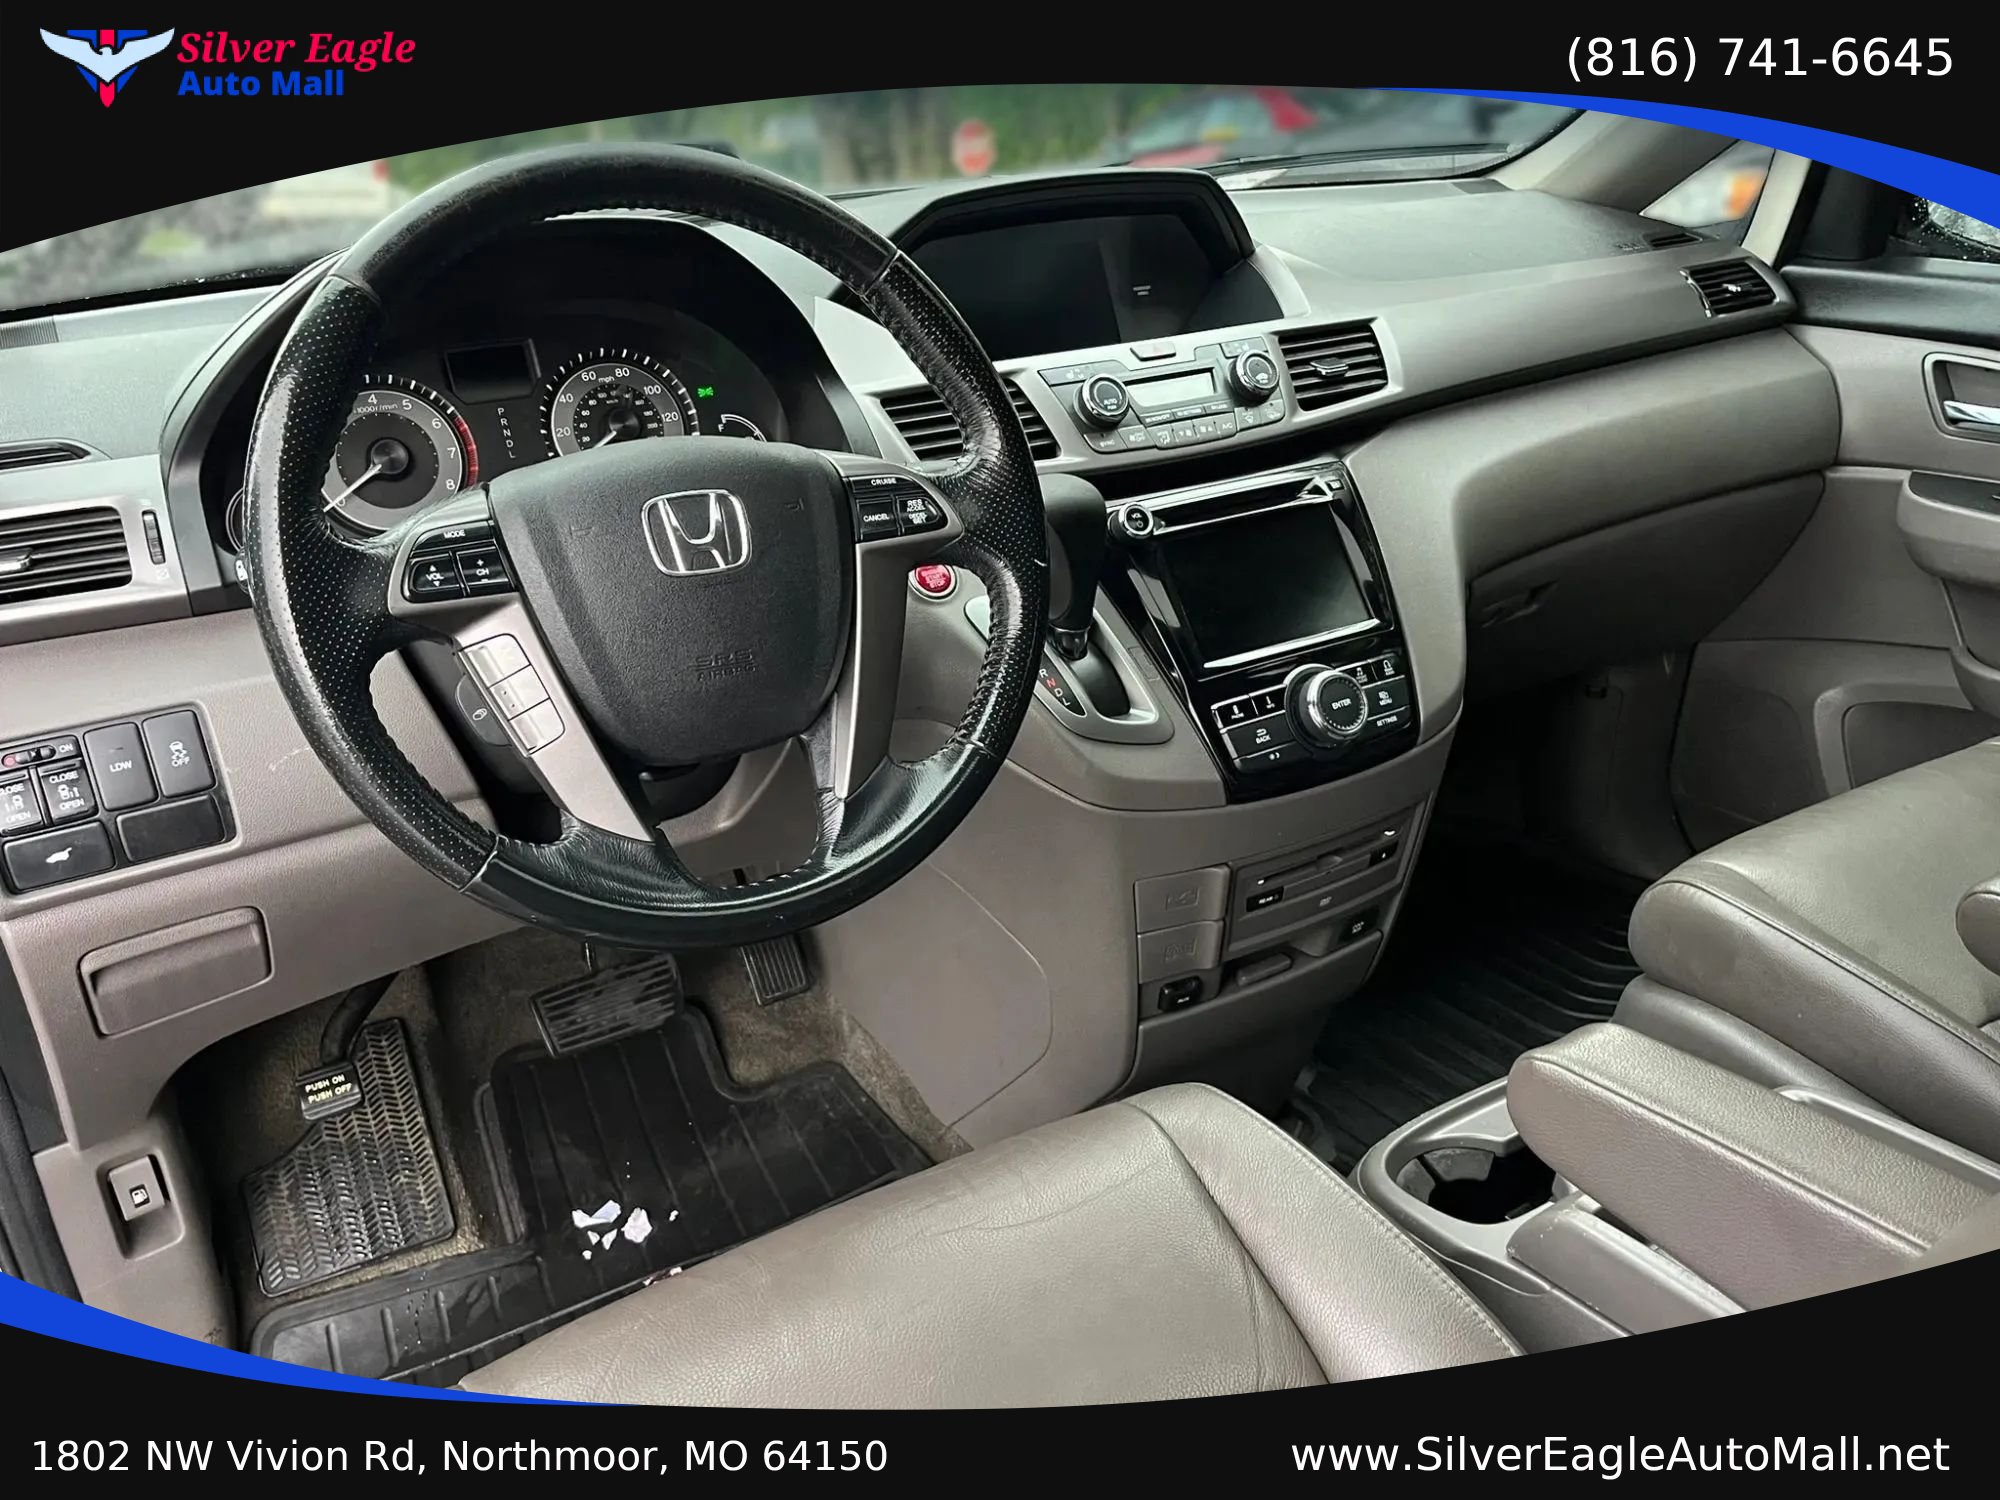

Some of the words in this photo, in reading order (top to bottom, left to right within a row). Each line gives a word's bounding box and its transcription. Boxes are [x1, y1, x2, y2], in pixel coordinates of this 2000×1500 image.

[581, 371, 597, 381] 60
[614, 367, 630, 378] 80
[598, 375, 615, 383] mph
[643, 384, 662, 396] 100
[367, 393, 378, 404] 4
[402, 398, 413, 410] 5
[559, 393, 574, 403] 40
[661, 410, 679, 423] 120
[431, 417, 443, 430] 6
[717, 423, 725, 433] F
[555, 426, 571, 438] 20
[447, 446, 457, 460] 7
[445, 478, 456, 492] 8
[870, 477, 897, 486] CRUISE
[863, 514, 890, 523] CANCEL
[443, 529, 466, 539] MODE
[426, 573, 445, 582] VOL
[1331, 698, 1352, 710] ENTER
[59, 743, 74, 753] ON
[109, 759, 133, 772] LDW
[171, 756, 190, 767] OFF
[49, 770, 79, 784] CLOSE
[0, 783, 24, 795] LOSE
[305, 1079, 330, 1094] PUSH
[331, 1074, 345, 1085] ON
[307, 1089, 333, 1105] PUSH
[334, 1082, 352, 1096] OFF
